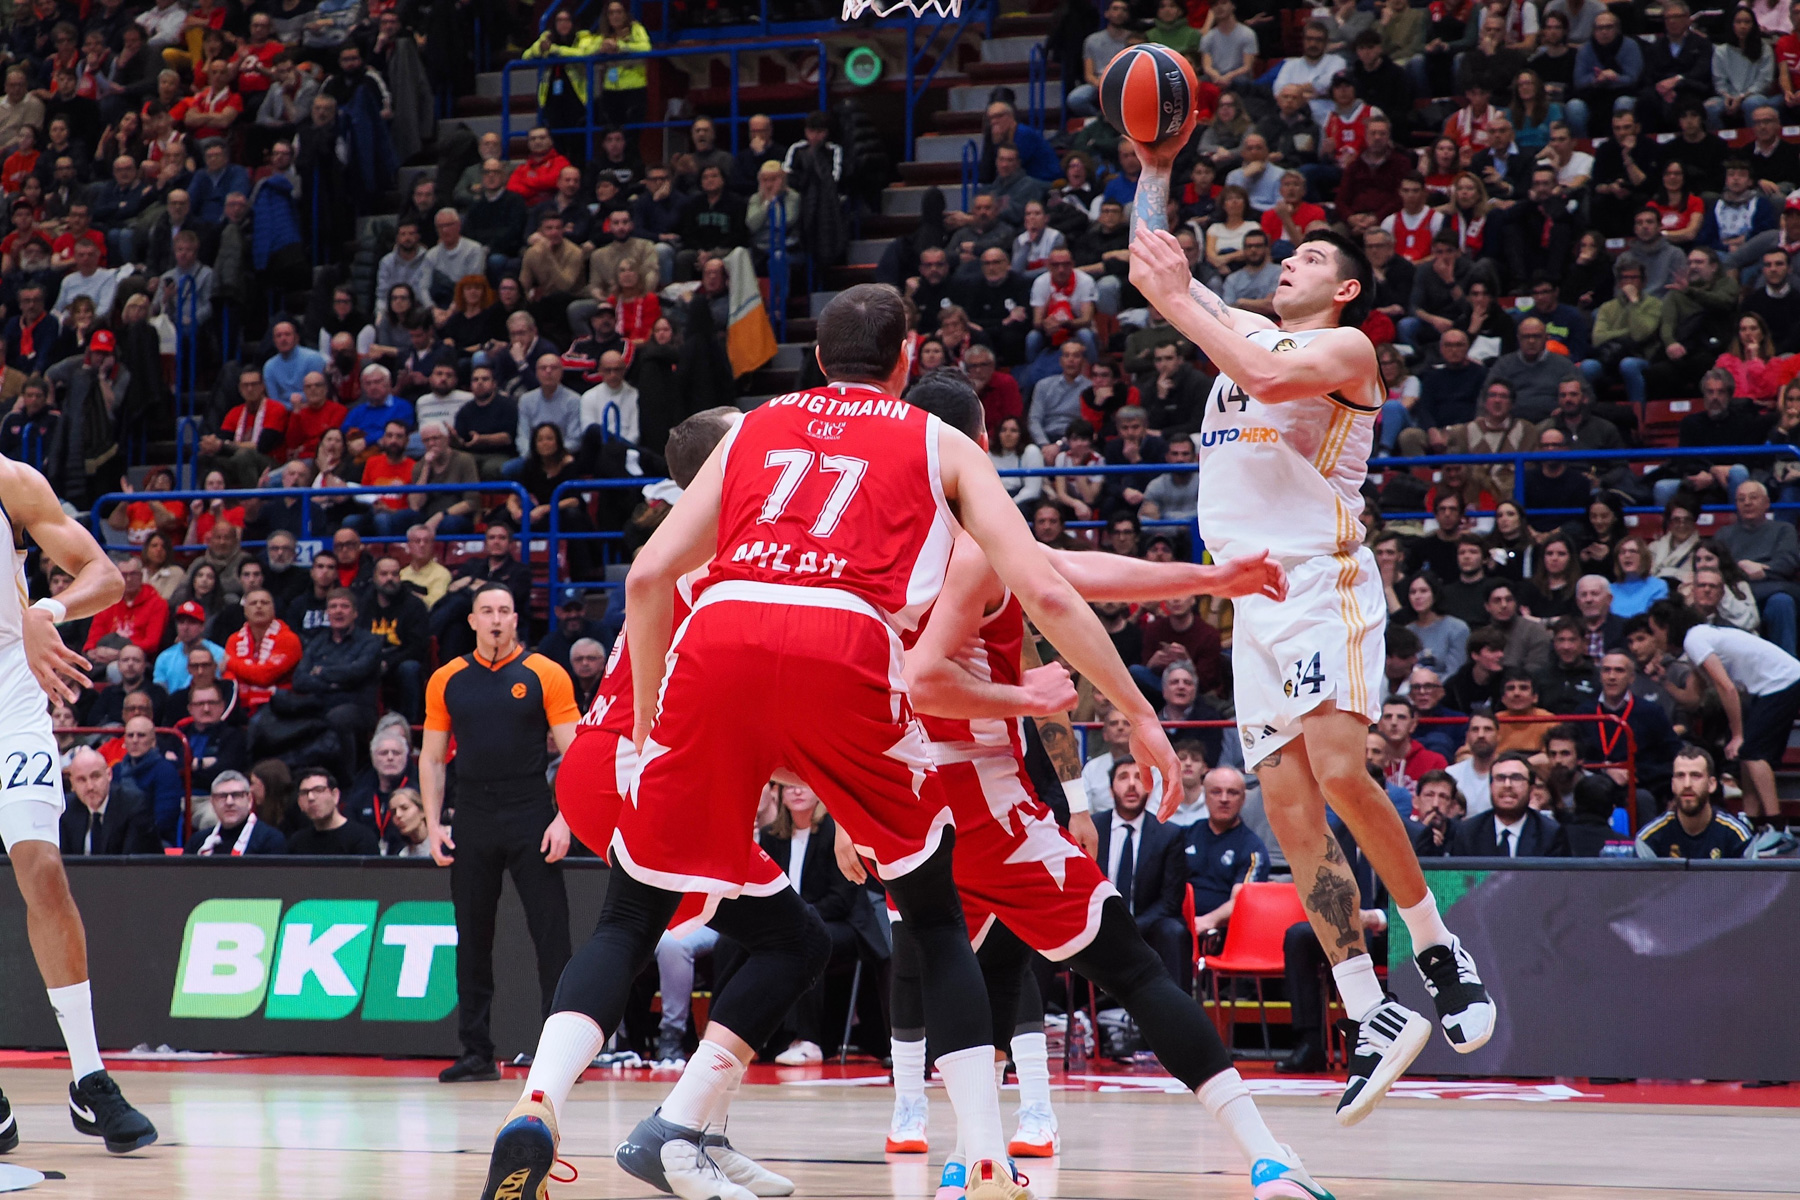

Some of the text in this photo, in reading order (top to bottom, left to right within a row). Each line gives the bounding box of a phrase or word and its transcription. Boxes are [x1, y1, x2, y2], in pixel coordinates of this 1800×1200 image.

[768, 392, 910, 421] VOIGTMANN
[1217, 383, 1250, 413] 14
[1201, 427, 1279, 447] UTOHERO
[756, 448, 869, 538] 77
[731, 541, 848, 578] MILAN
[1293, 651, 1326, 698] 14
[5, 751, 54, 790] 22
[181, 922, 459, 998] BKT
